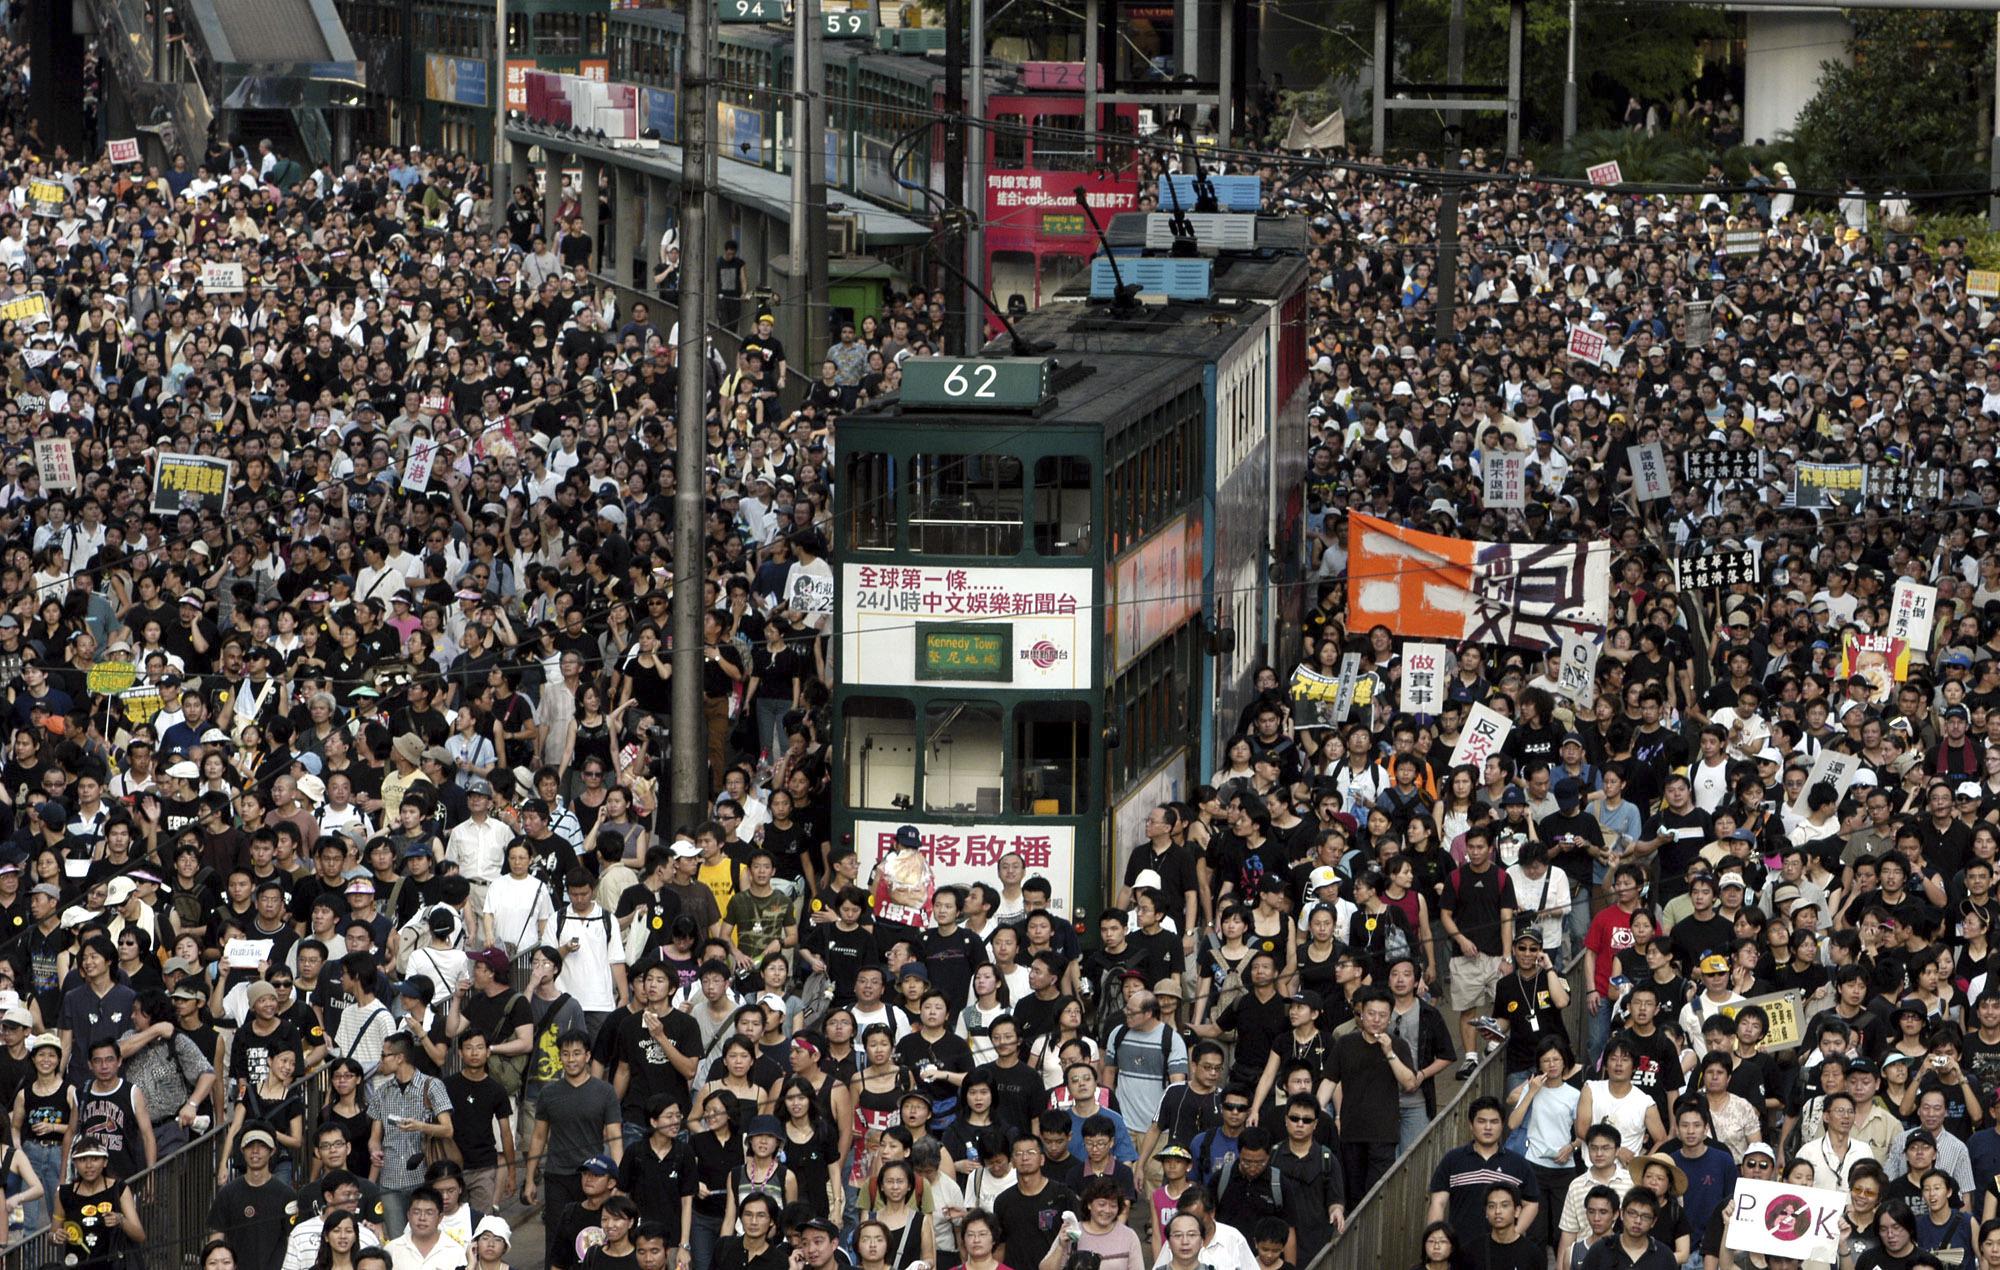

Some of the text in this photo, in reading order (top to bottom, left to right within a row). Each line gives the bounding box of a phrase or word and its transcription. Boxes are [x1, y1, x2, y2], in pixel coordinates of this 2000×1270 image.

[736, 0, 765, 17] 94
[827, 15, 862, 33] 59
[943, 364, 997, 397] 62
[54, 444, 70, 482] 創作自由
[407, 443, 430, 483] 救港
[1690, 451, 1758, 464] 董建華上台
[1489, 459, 1504, 500] 絕不退讓
[1505, 459, 1520, 500] 創作自由
[1640, 450, 1660, 492] 還政於民
[1689, 465, 1758, 479] 港經濟落台
[1870, 466, 1938, 482] 董建華上台
[1867, 482, 1938, 498] 港經濟落台
[1681, 550, 1753, 573] 董建華上台
[1681, 568, 1755, 589] 港經濟落台
[857, 590, 1078, 615] 24小時中文娛樂新聞台
[1912, 596, 1928, 619] 打倒
[927, 635, 999, 651] Kennedy Town
[1020, 649, 1069, 661] 娛樂新聞台
[1409, 654, 1435, 705] 做實事
[1461, 718, 1499, 767] 反吹水
